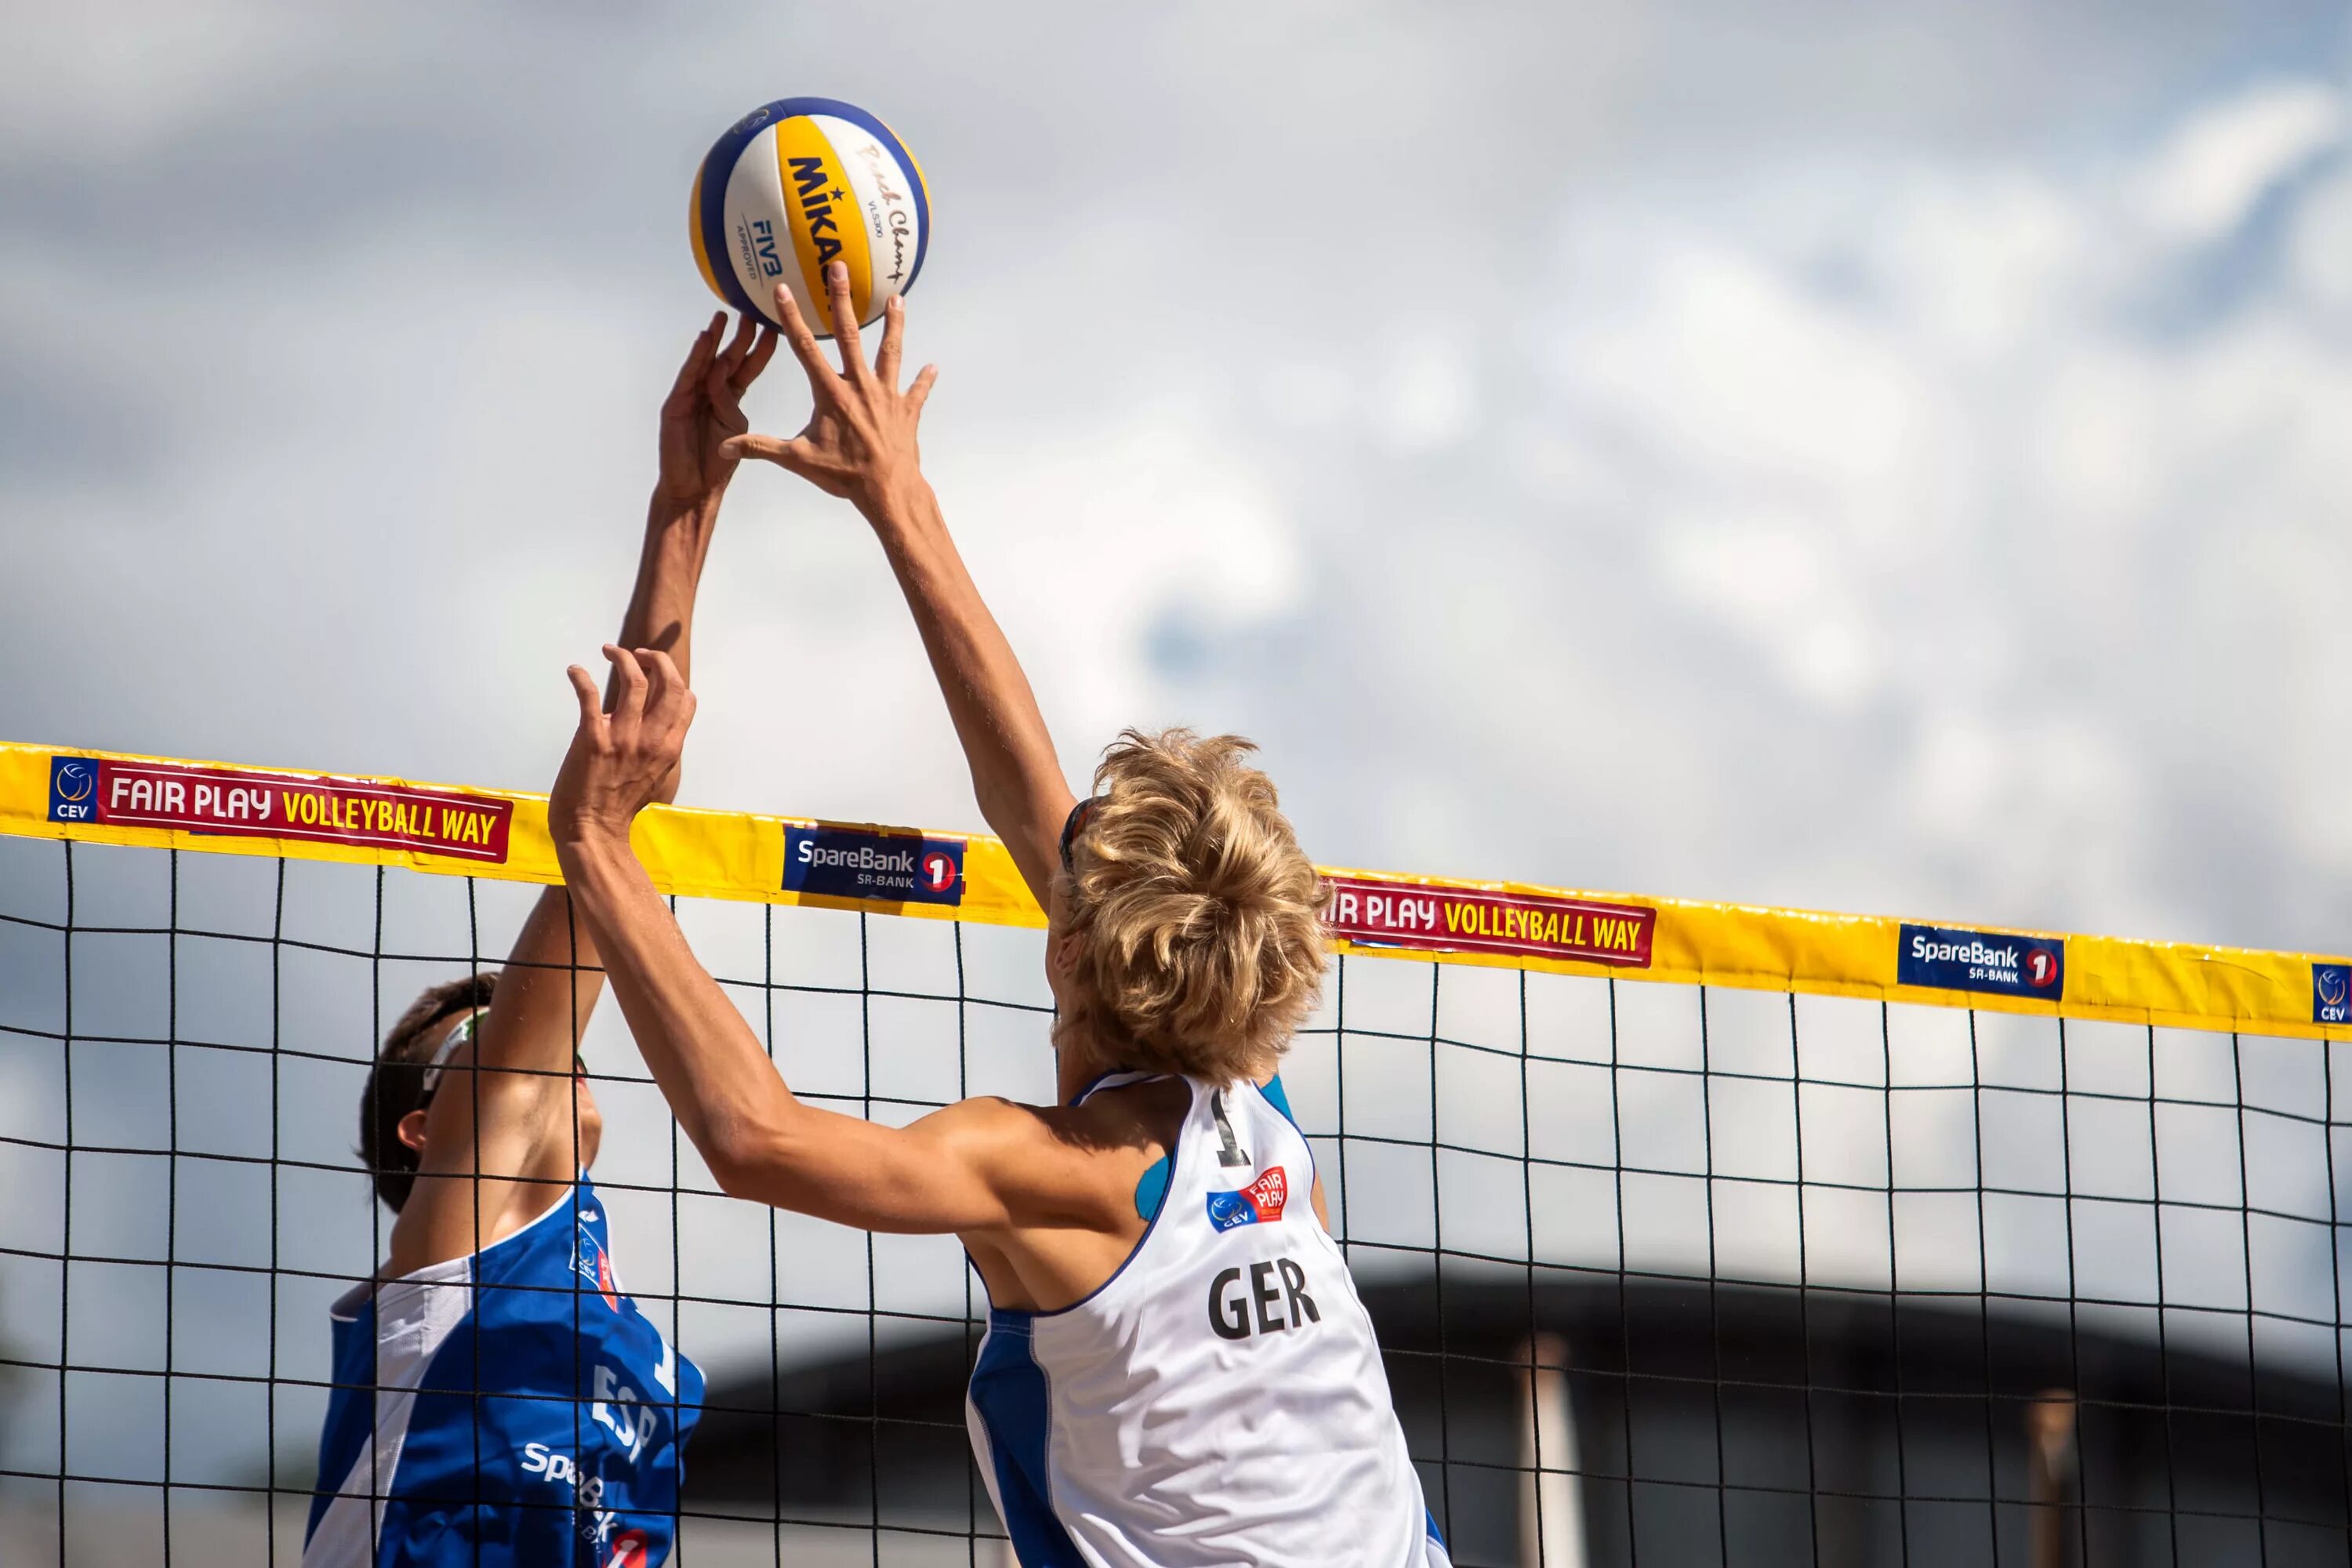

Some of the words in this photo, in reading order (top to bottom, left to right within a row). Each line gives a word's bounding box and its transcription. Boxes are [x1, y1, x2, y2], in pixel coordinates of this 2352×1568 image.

[868, 201, 883, 238] VLS300
[737, 225, 757, 280] APPROVED
[56, 804, 89, 819] CEV
[111, 778, 186, 814] FAIR
[194, 786, 271, 821] PLAY
[282, 792, 435, 837] VOLLEYBALL
[441, 809, 497, 846] WAY
[798, 840, 914, 873] SpareBank
[929, 858, 944, 885] 1
[857, 873, 914, 889] SR-BANK
[1367, 896, 1435, 929] PLAY
[1444, 902, 1586, 946] VOLLEYBALL
[1592, 916, 1642, 952] WAY
[1911, 935, 2019, 969] SpareBank
[2032, 954, 2046, 980] 1
[1969, 967, 2019, 984] SR-BANK
[2321, 1006, 2345, 1022] CEV
[1249, 1174, 1283, 1196] FAIR
[1255, 1189, 1283, 1208] PLAY
[1224, 1211, 1249, 1228] CEV
[1208, 1258, 1322, 1341] GER
[592, 1364, 659, 1465] ESP
